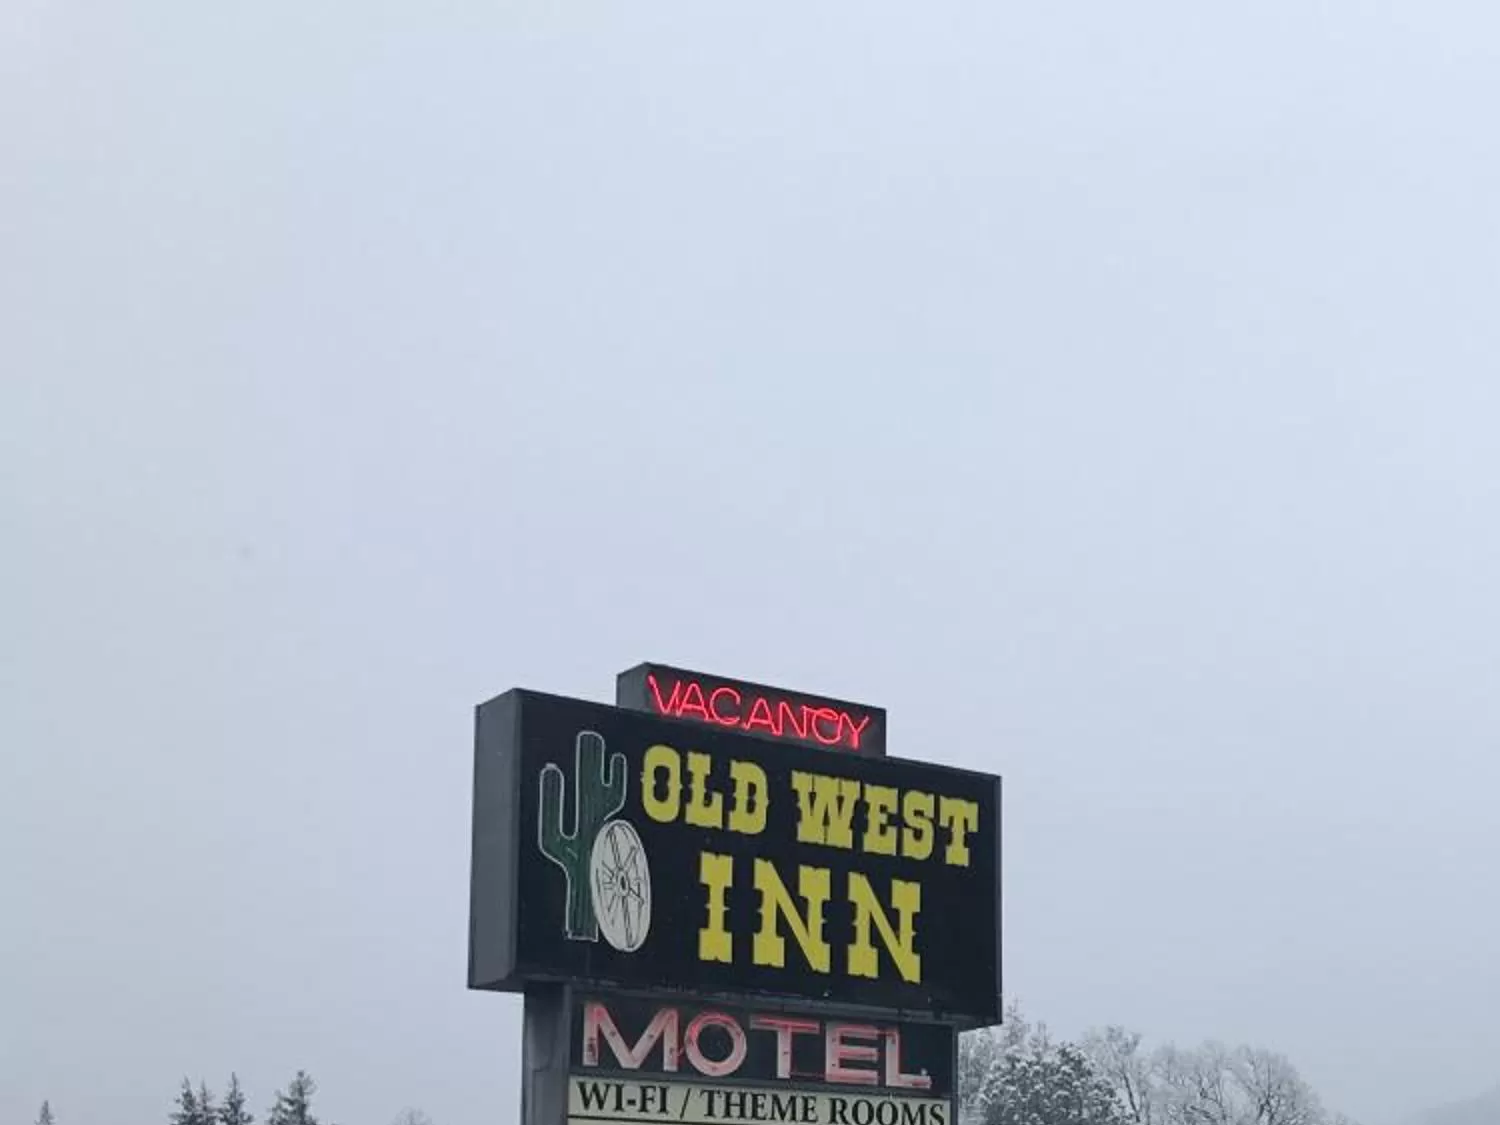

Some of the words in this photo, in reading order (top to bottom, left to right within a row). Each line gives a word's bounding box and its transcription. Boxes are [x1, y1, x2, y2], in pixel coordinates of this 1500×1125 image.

[641, 744, 768, 835] OLD
[791, 770, 978, 867] WEST
[699, 852, 921, 985] INN
[582, 1003, 932, 1090] MOTEL
[577, 1081, 668, 1115] WI-FI
[700, 1089, 818, 1124] THEME
